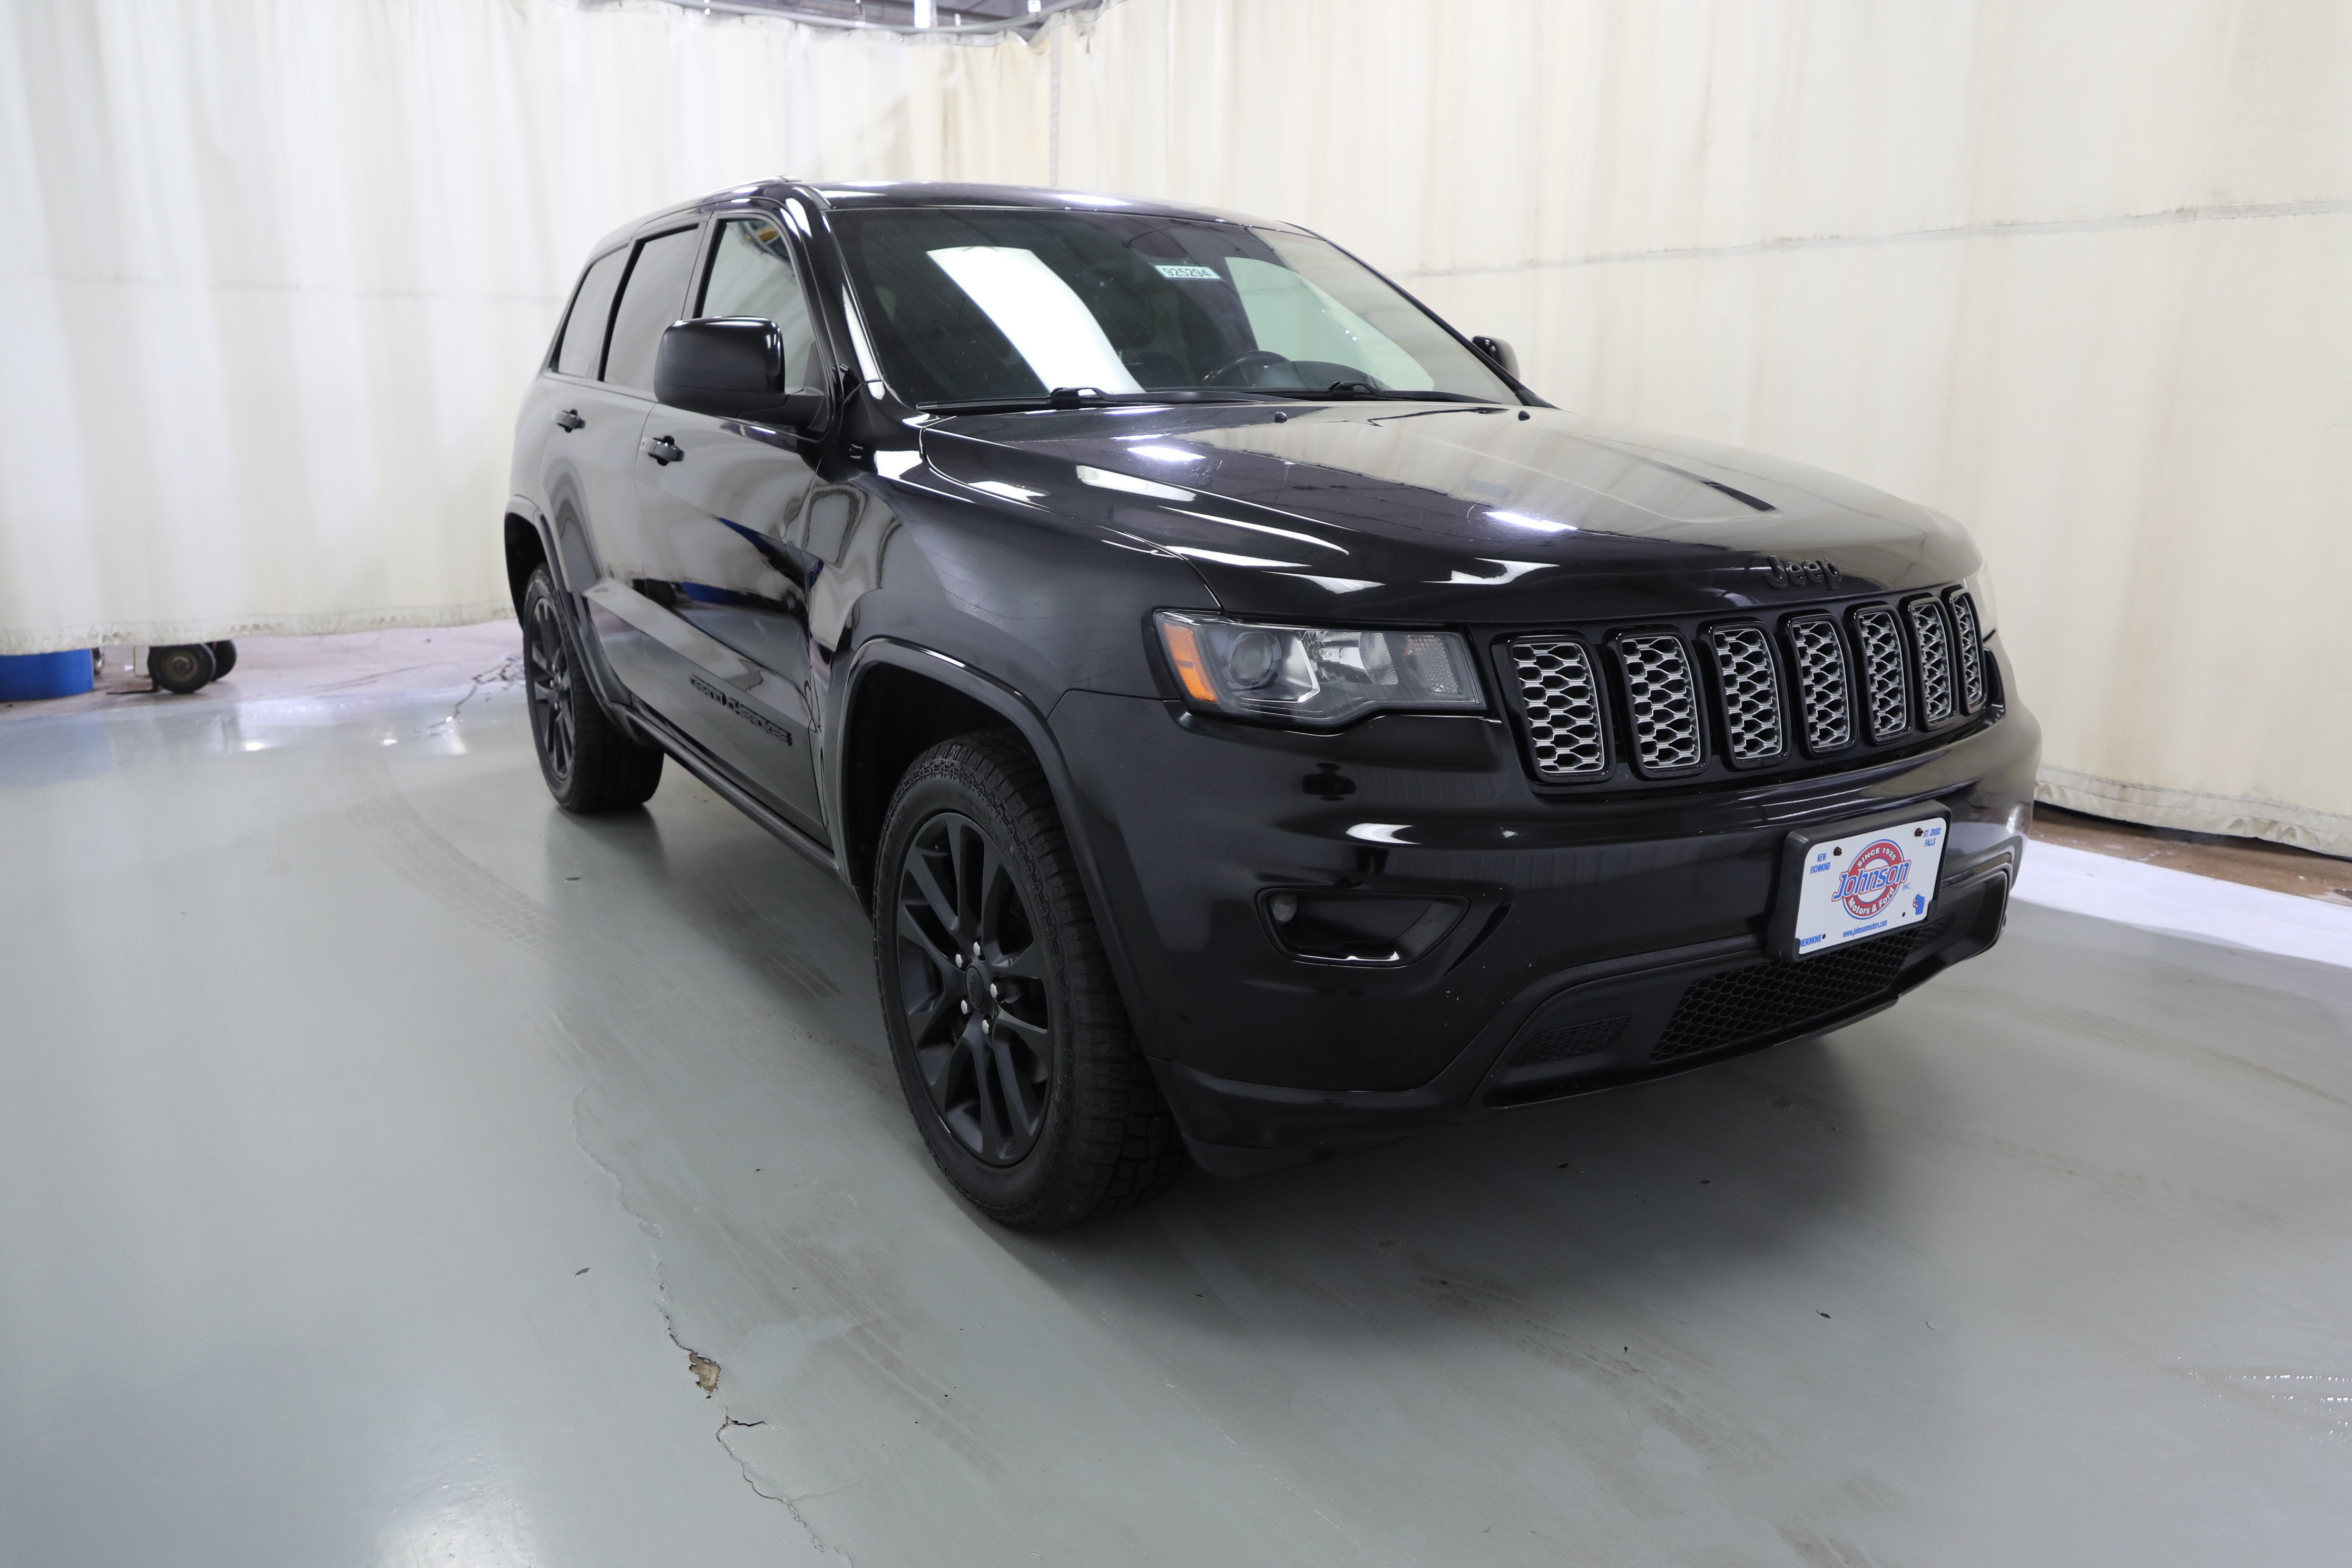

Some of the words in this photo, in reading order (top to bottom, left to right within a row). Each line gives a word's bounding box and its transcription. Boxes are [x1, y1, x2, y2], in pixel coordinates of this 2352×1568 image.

[1162, 268, 1211, 277] 925294
[1765, 555, 1842, 591] Jeep
[1924, 838, 1936, 847] FALLS
[1817, 852, 1827, 862] NEW
[1857, 848, 1880, 868] SINCE
[1882, 847, 1897, 861] 1925
[1810, 862, 1830, 874] RICHMOND
[1833, 861, 1910, 900] Johnson
[1848, 897, 1870, 915] Motors
[1871, 905, 1877, 913] &
[1878, 887, 1895, 907] Ford
[1843, 920, 1888, 938] www.johnsonmotors.com
